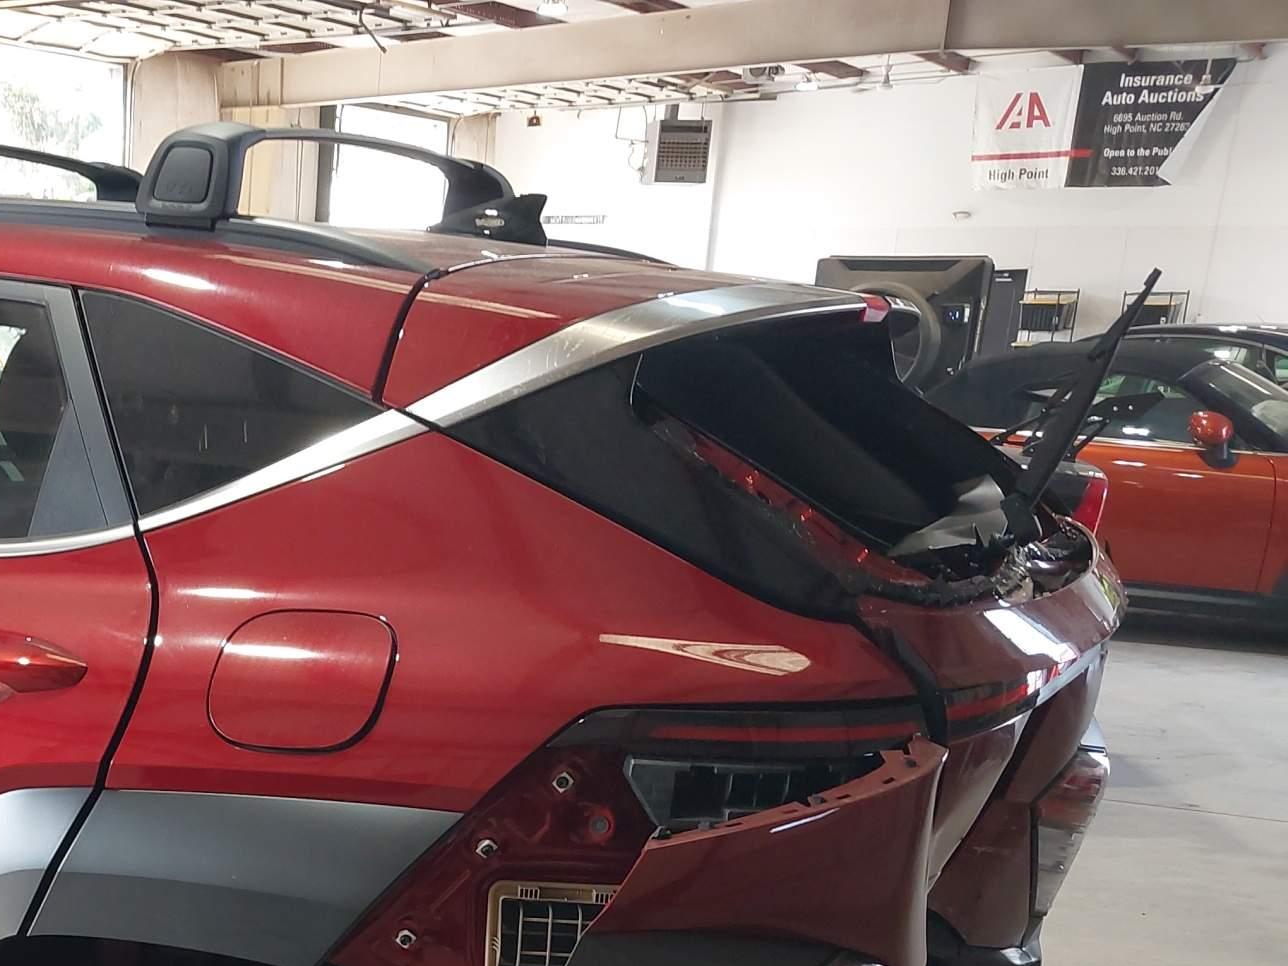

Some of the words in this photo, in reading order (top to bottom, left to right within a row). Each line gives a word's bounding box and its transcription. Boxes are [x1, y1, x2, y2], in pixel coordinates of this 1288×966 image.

[1120, 73, 1193, 88] Insurance
[1101, 90, 1135, 106] Auto
[1138, 88, 1205, 104] Auctions
[1135, 112, 1168, 122] Auction
[1169, 111, 1184, 121] Rd.
[1103, 124, 1122, 135] High
[1149, 122, 1163, 132] NC
[1103, 147, 1125, 159] Open
[1127, 148, 1135, 157] to
[1137, 146, 1151, 156] the
[988, 168, 1015, 183] High
[1018, 167, 1049, 180] Point
[1110, 166, 1161, 176] 336.421.201
